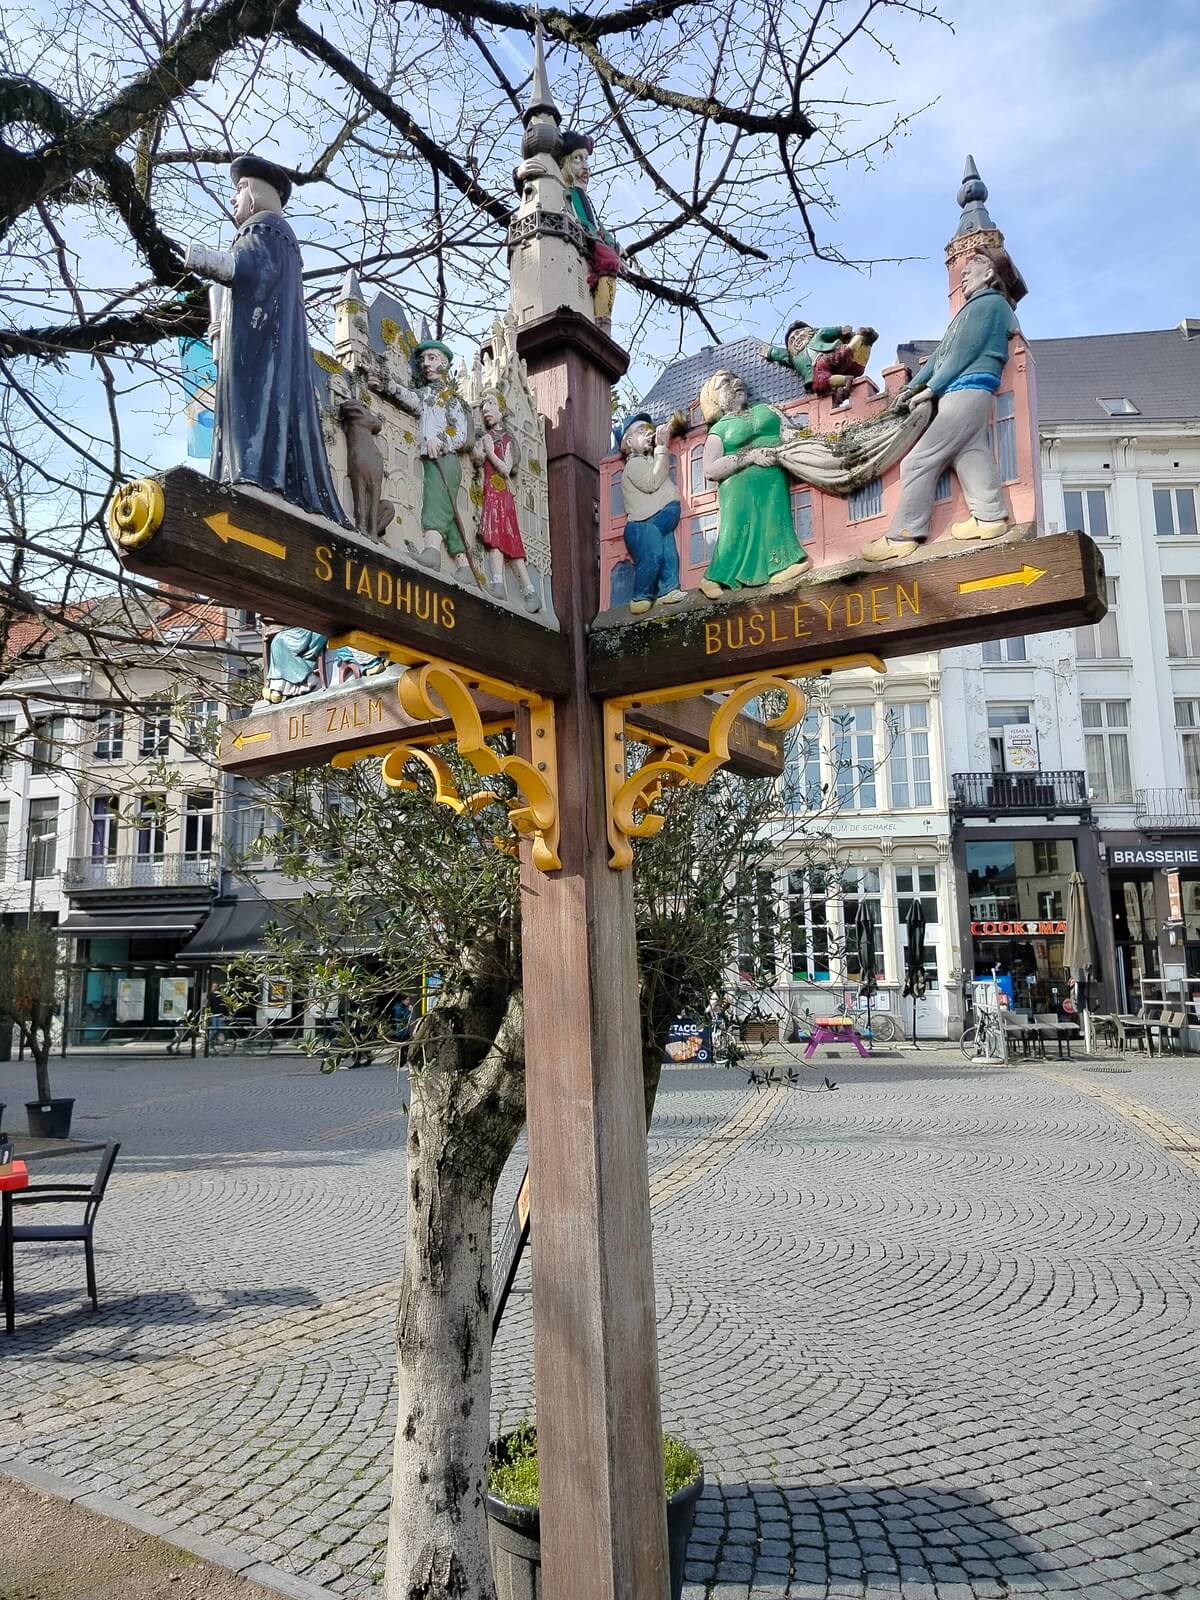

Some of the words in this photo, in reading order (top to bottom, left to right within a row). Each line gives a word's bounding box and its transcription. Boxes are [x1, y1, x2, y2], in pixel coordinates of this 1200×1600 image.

[314, 545, 456, 629] STADHUIS
[704, 578, 921, 655] BUSLEYDEN
[288, 712, 313, 741] DE
[326, 697, 384, 734] ZALM
[849, 824, 861, 832] DE
[862, 823, 897, 832] SCHAKEL
[1113, 850, 1199, 864] BRASSERIE
[970, 921, 1025, 936] COOK
[1038, 920, 1068, 935] MA
